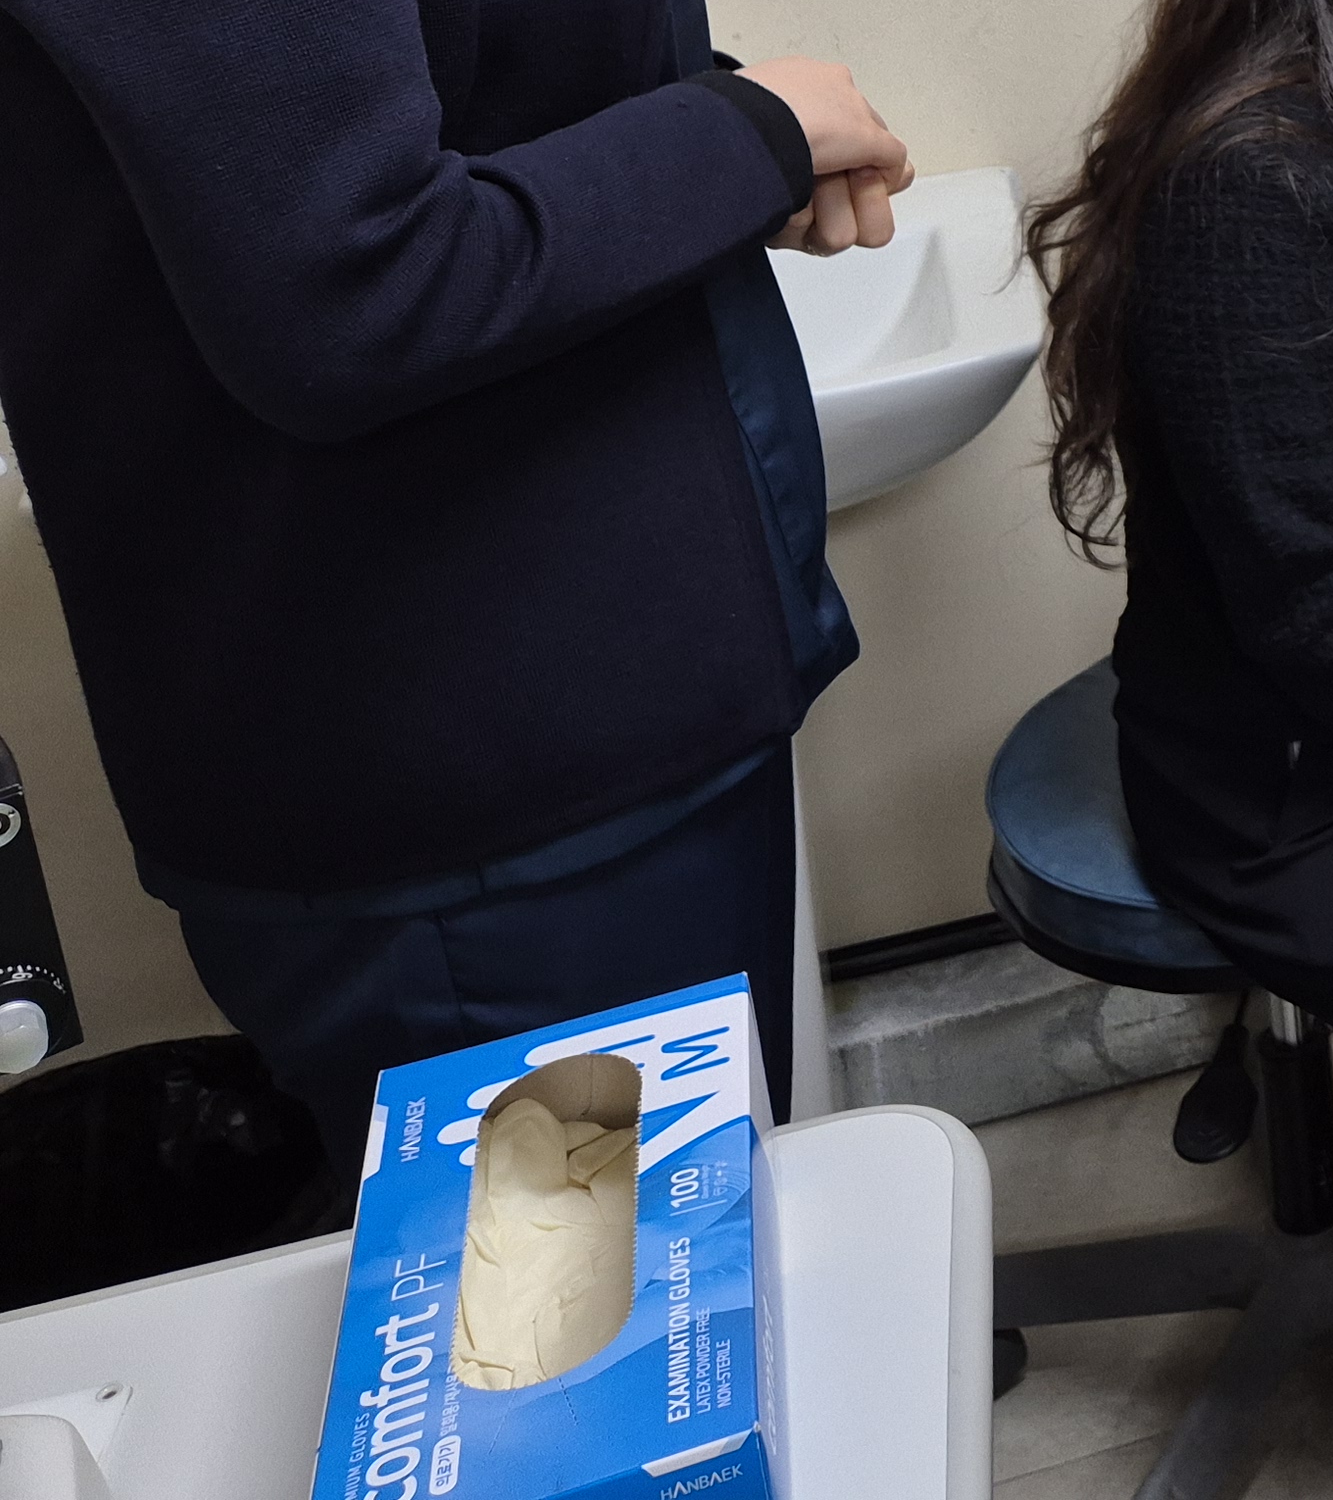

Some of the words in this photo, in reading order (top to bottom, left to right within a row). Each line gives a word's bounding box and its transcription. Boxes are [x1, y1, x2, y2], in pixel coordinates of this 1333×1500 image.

[660, 1026, 731, 1081] M
[398, 1096, 427, 1163] HANBAEK
[669, 1166, 700, 1208] 100
[391, 1252, 447, 1301] PF
[668, 1236, 692, 1301] GLOVES
[696, 1306, 711, 1332] FREE
[667, 1301, 692, 1423] EXAMINATION
[696, 1332, 711, 1378] POWDER
[716, 1338, 731, 1409] NON-STERILE
[696, 1378, 711, 1414] LATEX
[350, 1411, 370, 1462] GLOVES
[436, 1440, 457, 1487] 의료기기
[660, 1463, 743, 1500] HANBAEK
